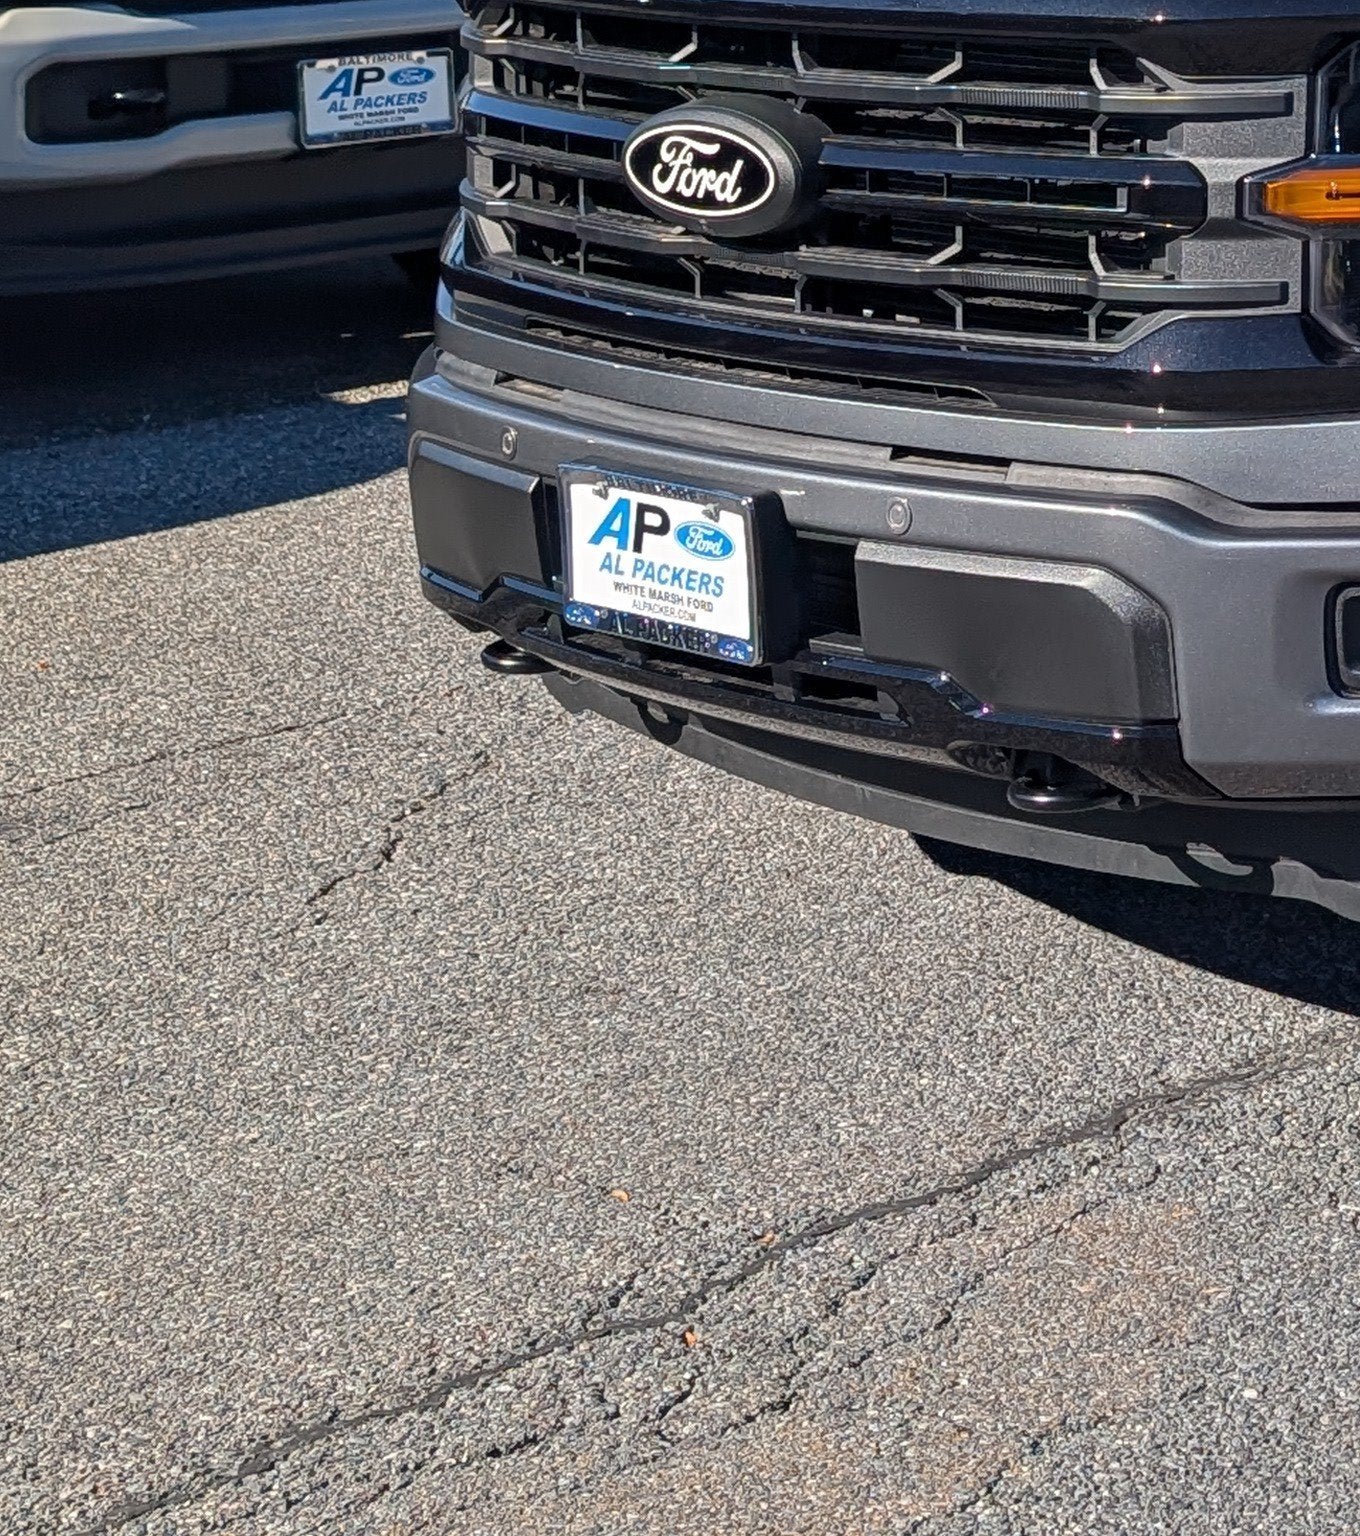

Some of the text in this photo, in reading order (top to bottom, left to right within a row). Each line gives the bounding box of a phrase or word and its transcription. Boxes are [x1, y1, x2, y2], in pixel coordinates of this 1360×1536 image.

[337, 52, 414, 66] BALTIMORE
[317, 66, 385, 102] AP
[327, 91, 428, 114] AL PACKERS
[652, 135, 744, 204] Ford
[588, 497, 671, 554] AP
[686, 525, 724, 556] Ford
[599, 552, 725, 598] AL PACKERS
[613, 581, 714, 613] WHITE MARSH FORD
